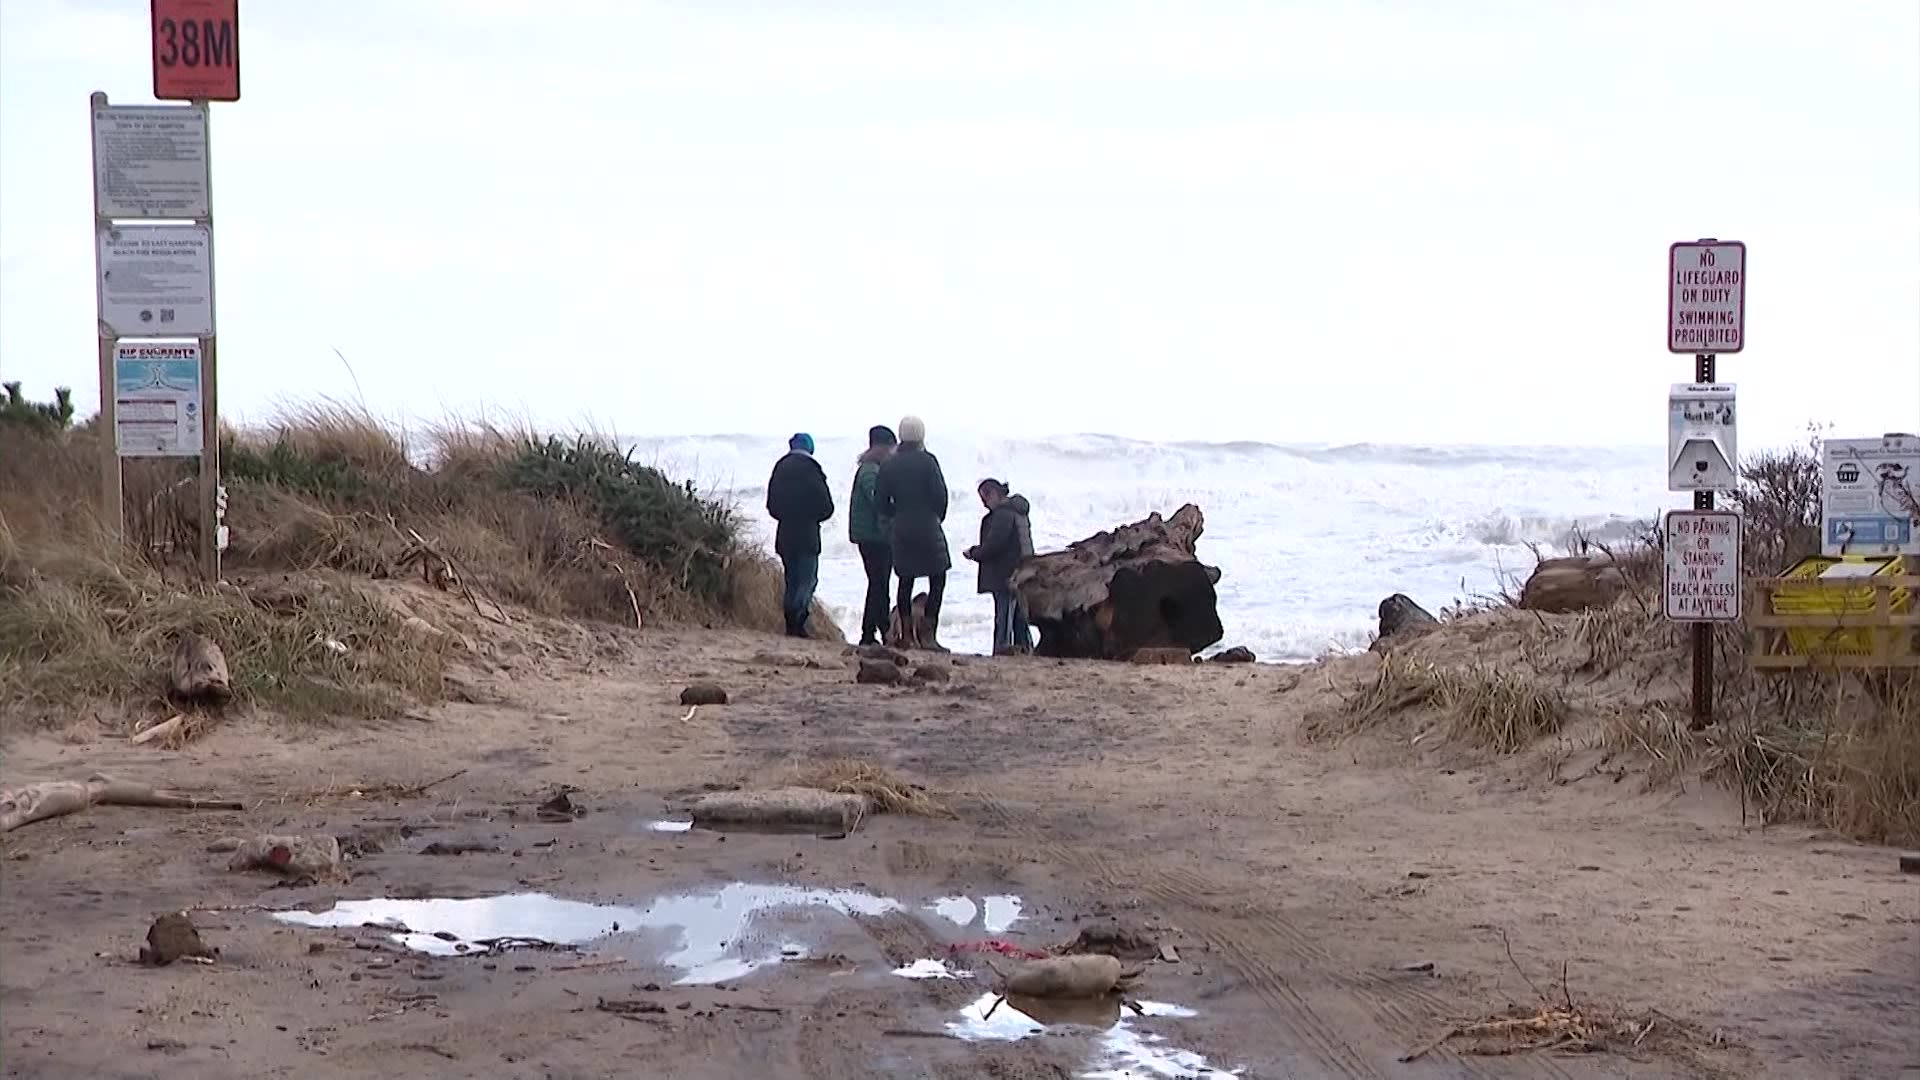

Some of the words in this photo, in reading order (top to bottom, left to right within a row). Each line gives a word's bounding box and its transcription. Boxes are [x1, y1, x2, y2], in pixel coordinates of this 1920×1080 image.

[160, 18, 232, 68] 38M
[1700, 252, 1715, 267] NO
[1677, 270, 1739, 285] LIFEGUARD
[1682, 288, 1698, 303] ON
[1702, 288, 1731, 303] DUTY
[1679, 310, 1734, 325] SWIMMING
[1675, 328, 1738, 343] PROHIBITED
[1678, 520, 1690, 534] NO
[1693, 520, 1730, 535] PARKING
[1697, 537, 1710, 550] OR
[1682, 552, 1725, 566] STANDING
[1688, 567, 1697, 581] IN
[1671, 583, 1699, 596] BEACH
[1702, 583, 1735, 597] ACCESS
[1678, 598, 1688, 612] AT
[1692, 598, 1728, 612] ANYTIME
